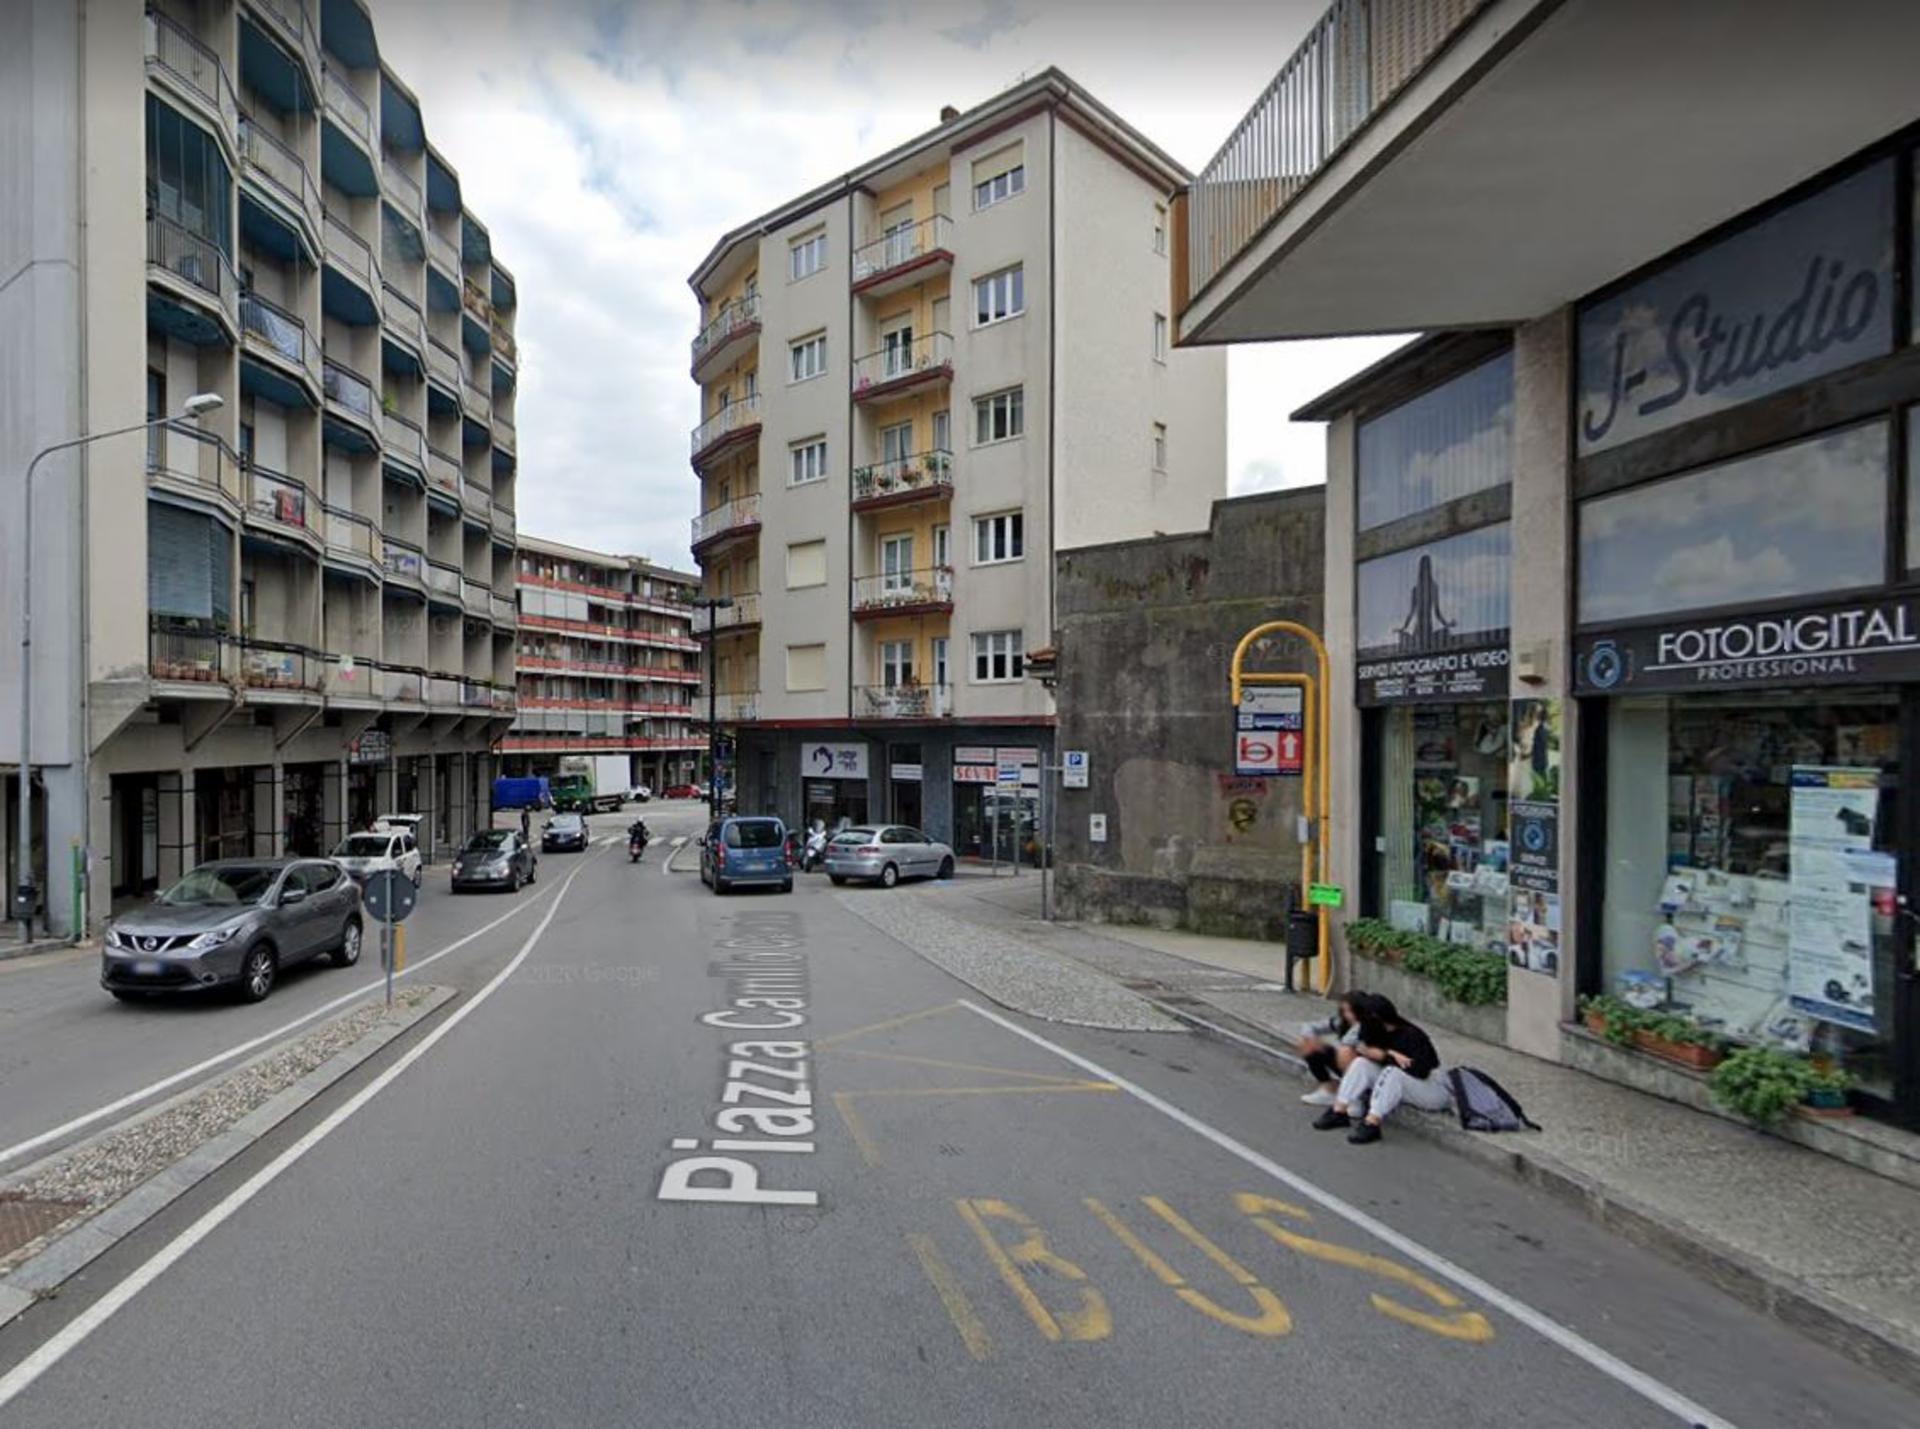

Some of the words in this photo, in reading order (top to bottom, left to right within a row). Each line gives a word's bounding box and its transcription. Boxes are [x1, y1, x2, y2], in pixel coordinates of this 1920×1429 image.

[1584, 255, 1879, 441] J-Studio
[1460, 654, 1468, 669] E
[1470, 649, 1510, 667] VIDEO
[1657, 605, 1919, 664] FOTODIGITAL
[1697, 655, 1857, 681] PROFESSIONAL
[954, 1192, 1496, 1342] BUS
